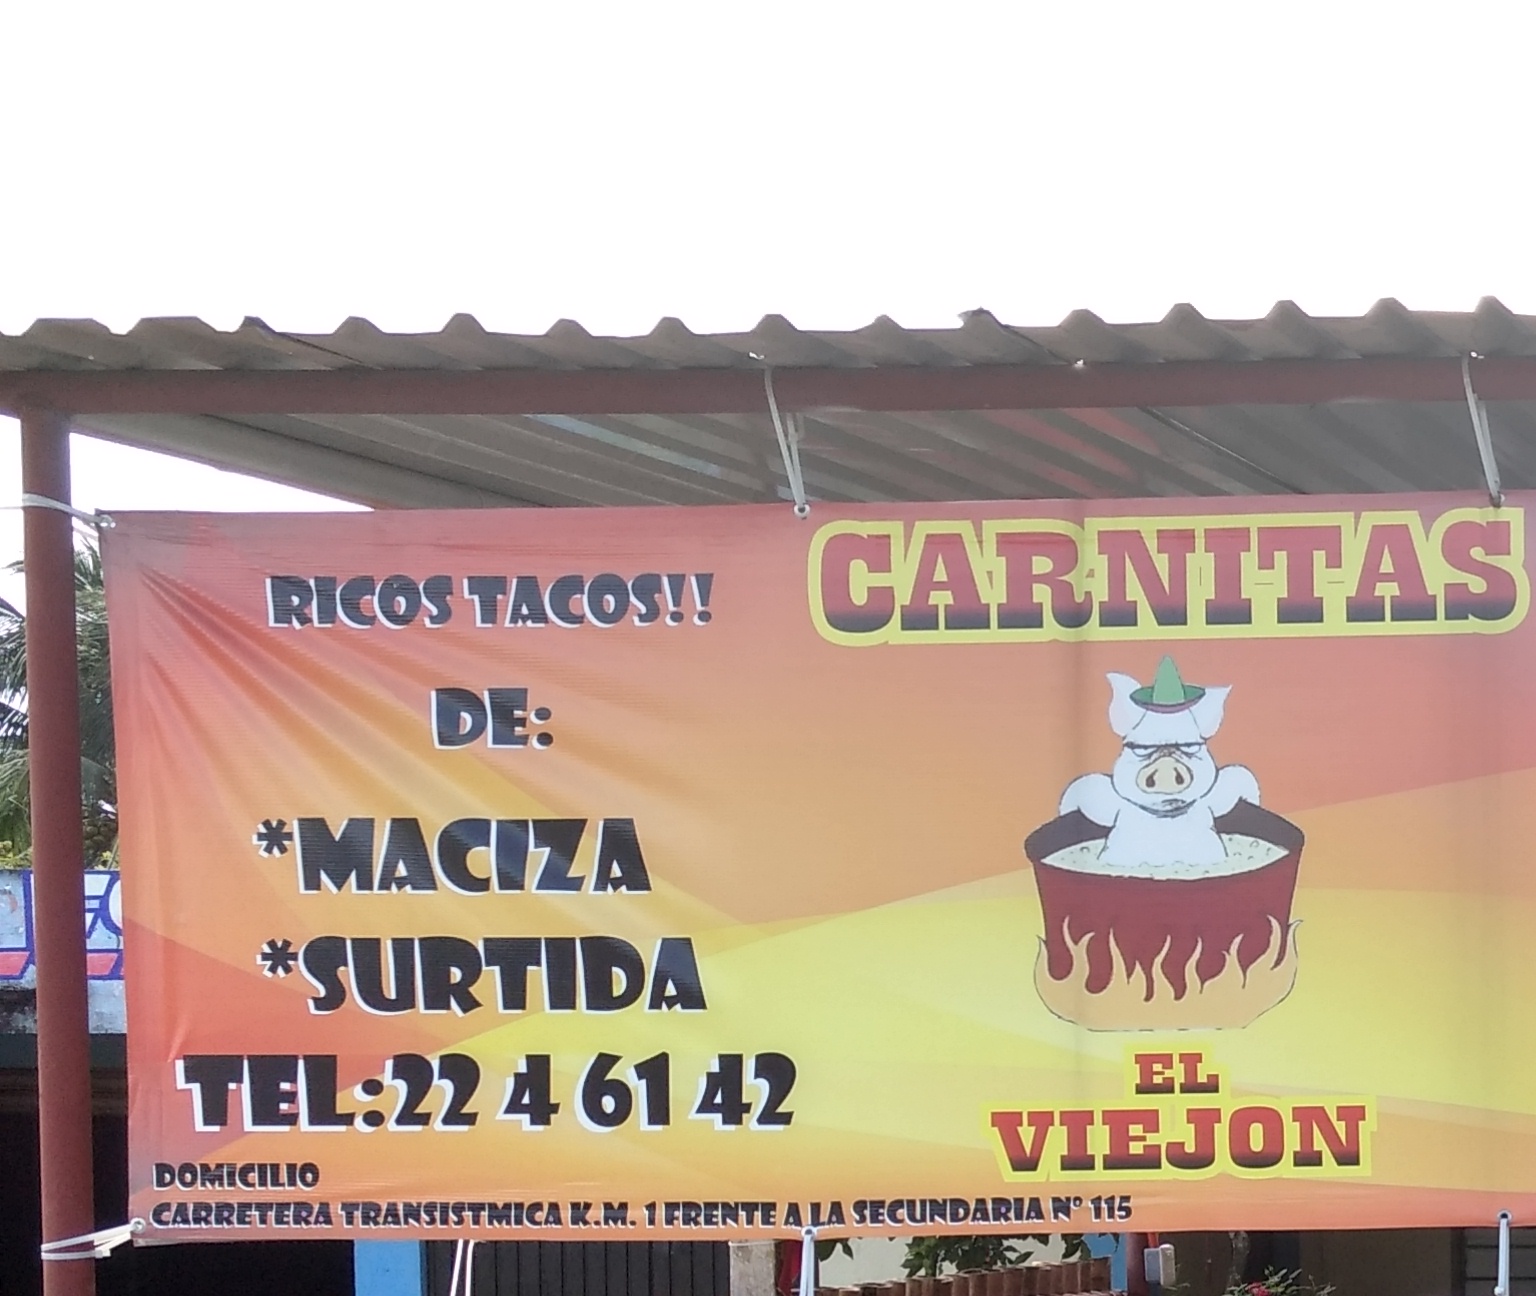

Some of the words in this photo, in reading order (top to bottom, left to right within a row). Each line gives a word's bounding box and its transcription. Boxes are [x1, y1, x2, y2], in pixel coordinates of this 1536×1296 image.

[265, 574, 453, 629] RICOS
[463, 573, 714, 628] TACOS!!
[818, 519, 1518, 633] CARNITAS
[431, 687, 554, 749] DE:
[496, 1053, 560, 1131] 4
[574, 1051, 671, 1132] 61
[689, 1052, 797, 1131] 42
[1135, 1053, 1220, 1095] EL
[990, 1105, 1366, 1172] VIEJON
[153, 1162, 320, 1191] DOMICILIO
[150, 1201, 332, 1230] CARRETERA
[341, 1201, 562, 1230] TRANSISTMICA
[568, 1200, 637, 1230] K.M.
[644, 1200, 657, 1228] 1
[663, 1200, 777, 1228] FRENTE
[781, 1201, 803, 1228] A
[809, 1200, 846, 1227] LA
[851, 1197, 1045, 1226] SECUNDARIA
[1088, 1195, 1133, 1223] 115
